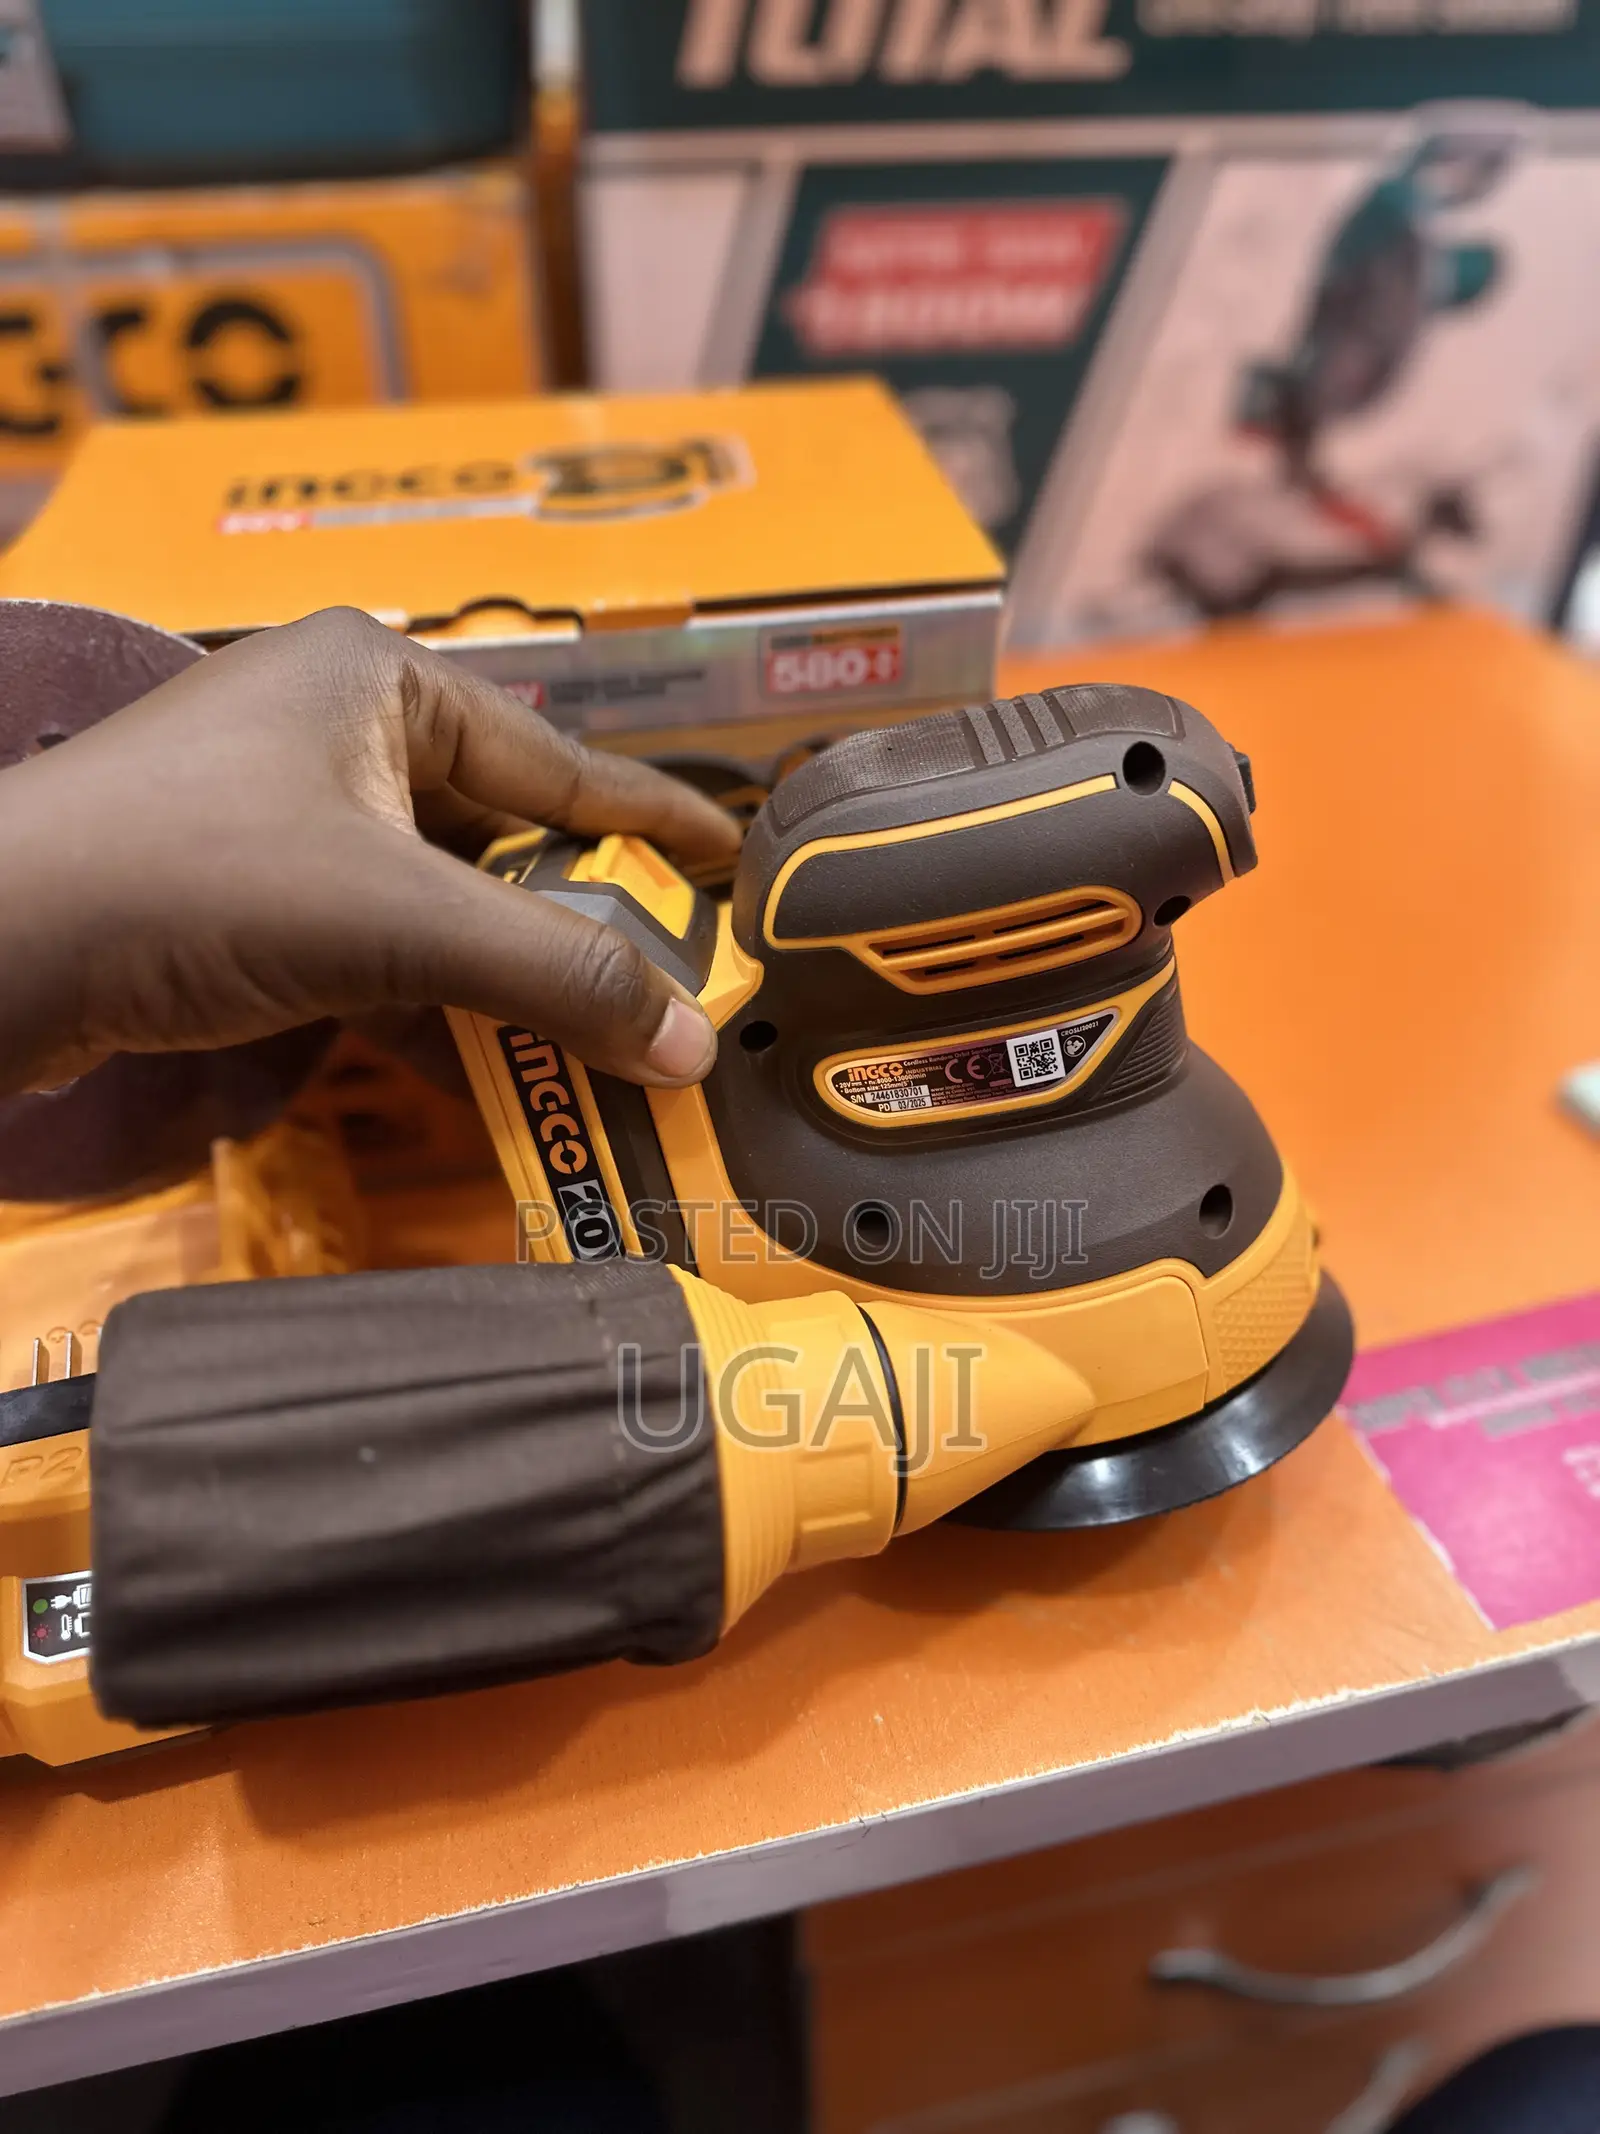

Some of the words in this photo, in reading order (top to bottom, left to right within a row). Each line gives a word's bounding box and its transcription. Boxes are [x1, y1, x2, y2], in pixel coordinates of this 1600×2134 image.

[844, 1086, 866, 1094] Bottom
[850, 1093, 865, 1104] S/N
[870, 1086, 923, 1101] 24461830701
[878, 1103, 891, 1112] PD
[897, 1098, 927, 1110] 03/2025
